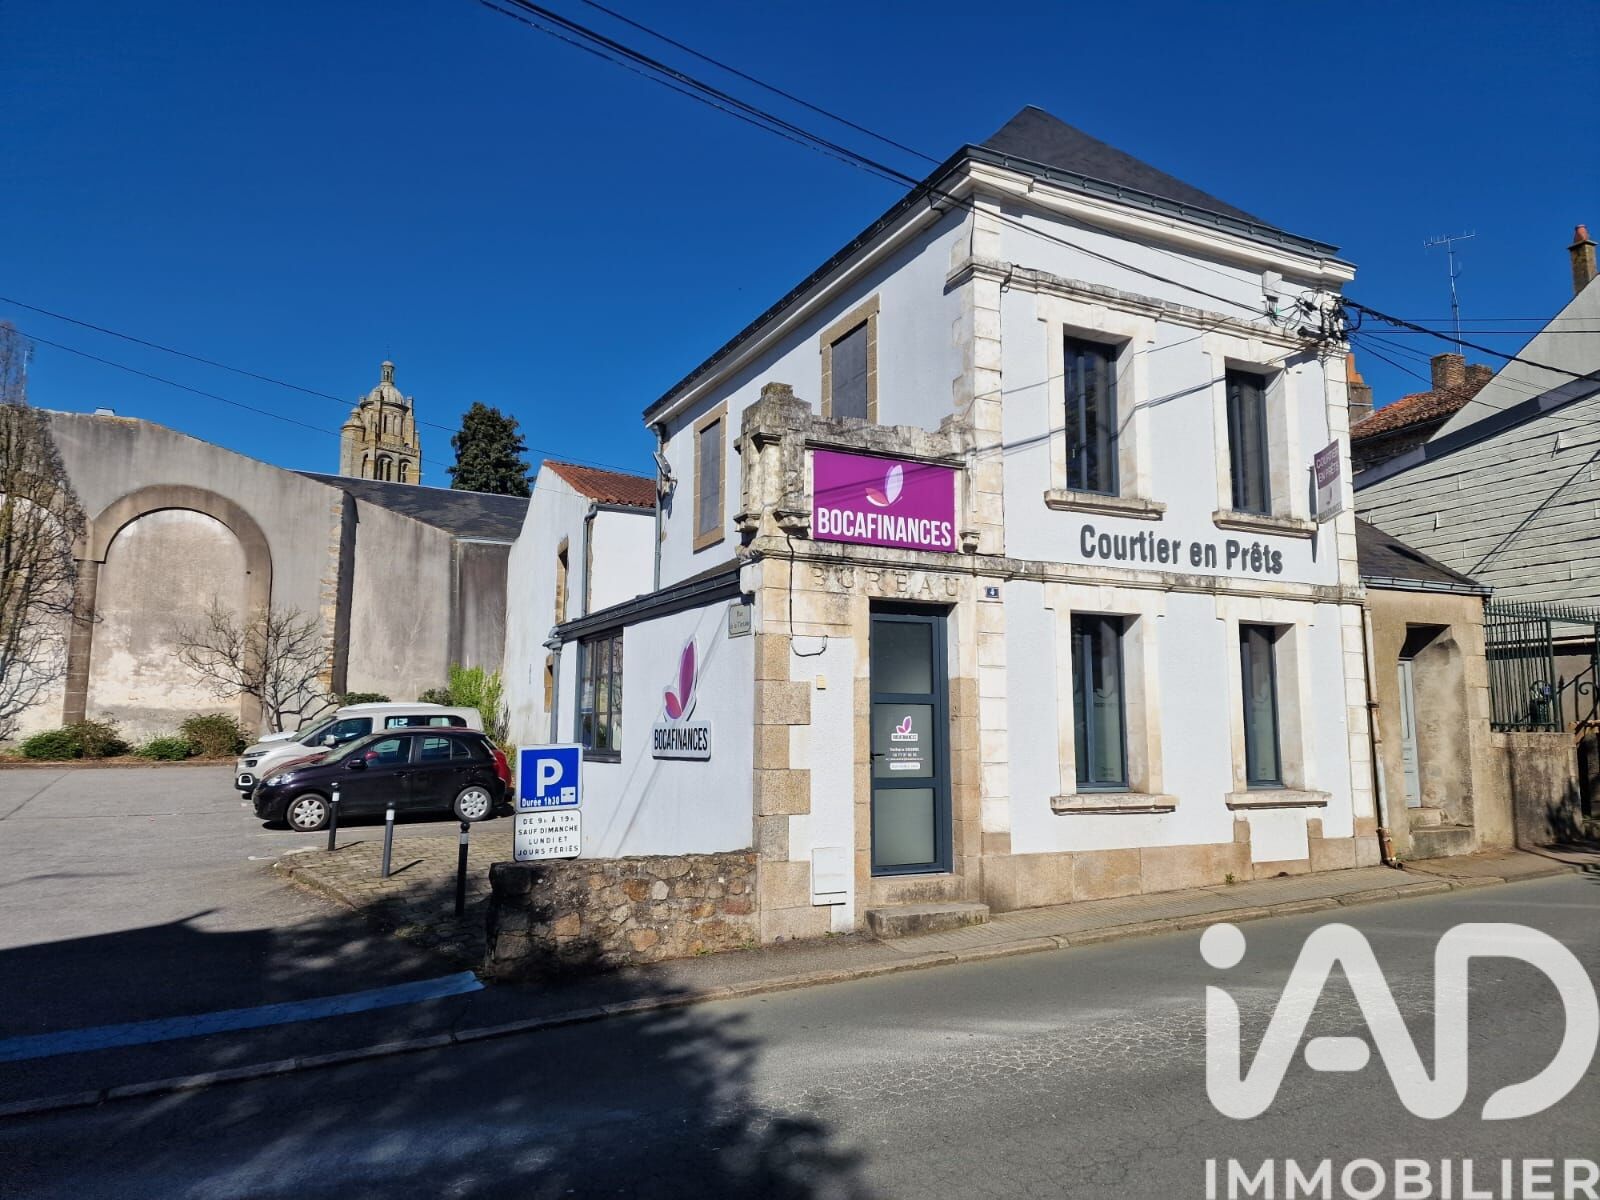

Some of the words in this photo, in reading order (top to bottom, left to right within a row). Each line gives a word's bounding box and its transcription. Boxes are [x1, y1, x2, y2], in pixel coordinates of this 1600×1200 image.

[817, 507, 952, 547] BOCAFINANCES
[1080, 523, 1181, 564] Courtier
[1189, 541, 1217, 568] en
[1225, 539, 1284, 575] Prêts
[810, 566, 961, 597] BUREAU
[654, 727, 708, 751] BOCAFINANCES
[536, 758, 564, 798] P
[521, 797, 542, 808] Durée
[544, 795, 560, 807] 1h30
[518, 828, 538, 836] SAUF
[540, 824, 579, 834] DIMANCHE
[528, 836, 555, 846] LUNDI
[558, 835, 568, 843] ET
[517, 848, 546, 857] JOURS
[549, 844, 579, 854] FÉRIÉS
